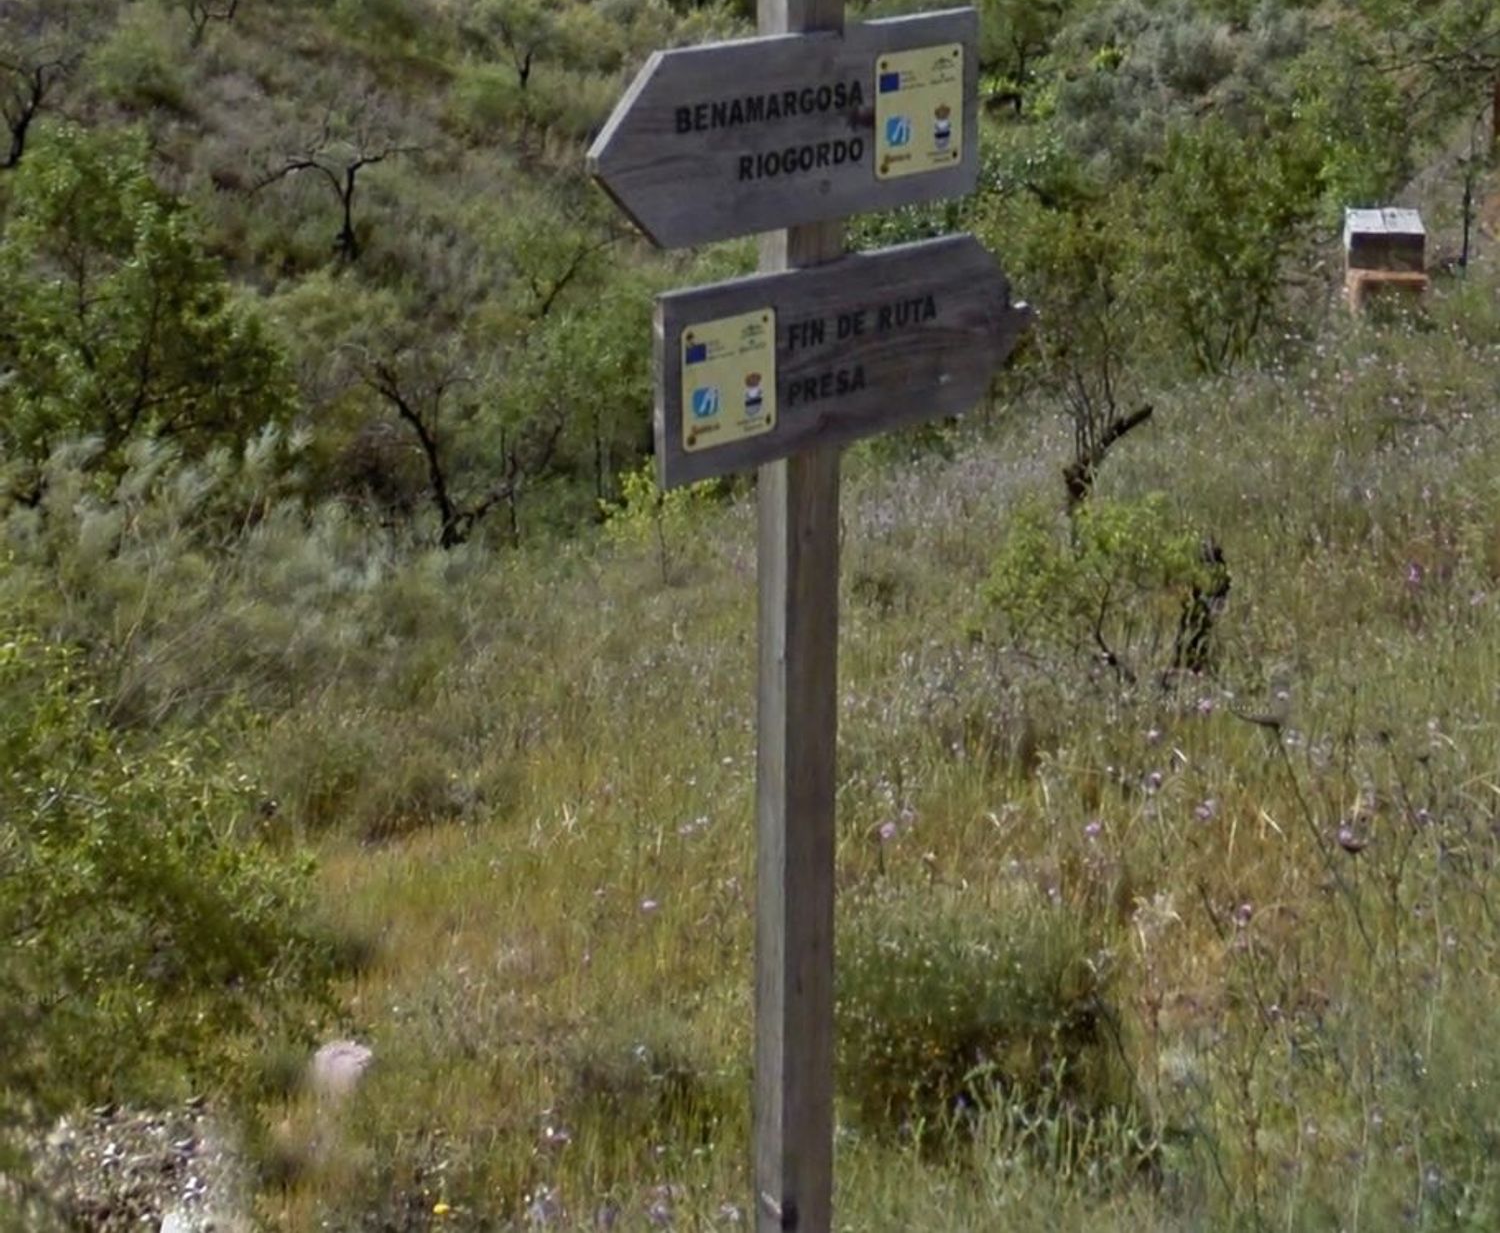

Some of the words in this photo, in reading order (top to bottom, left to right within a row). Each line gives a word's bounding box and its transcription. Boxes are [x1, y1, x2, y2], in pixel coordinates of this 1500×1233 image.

[675, 80, 864, 134] BENAMARGOSA
[738, 138, 864, 182] RIOGORDO
[788, 320, 824, 351] FIN
[837, 313, 865, 341] DE
[878, 295, 937, 332] RUTA
[787, 366, 866, 407] PRESA
